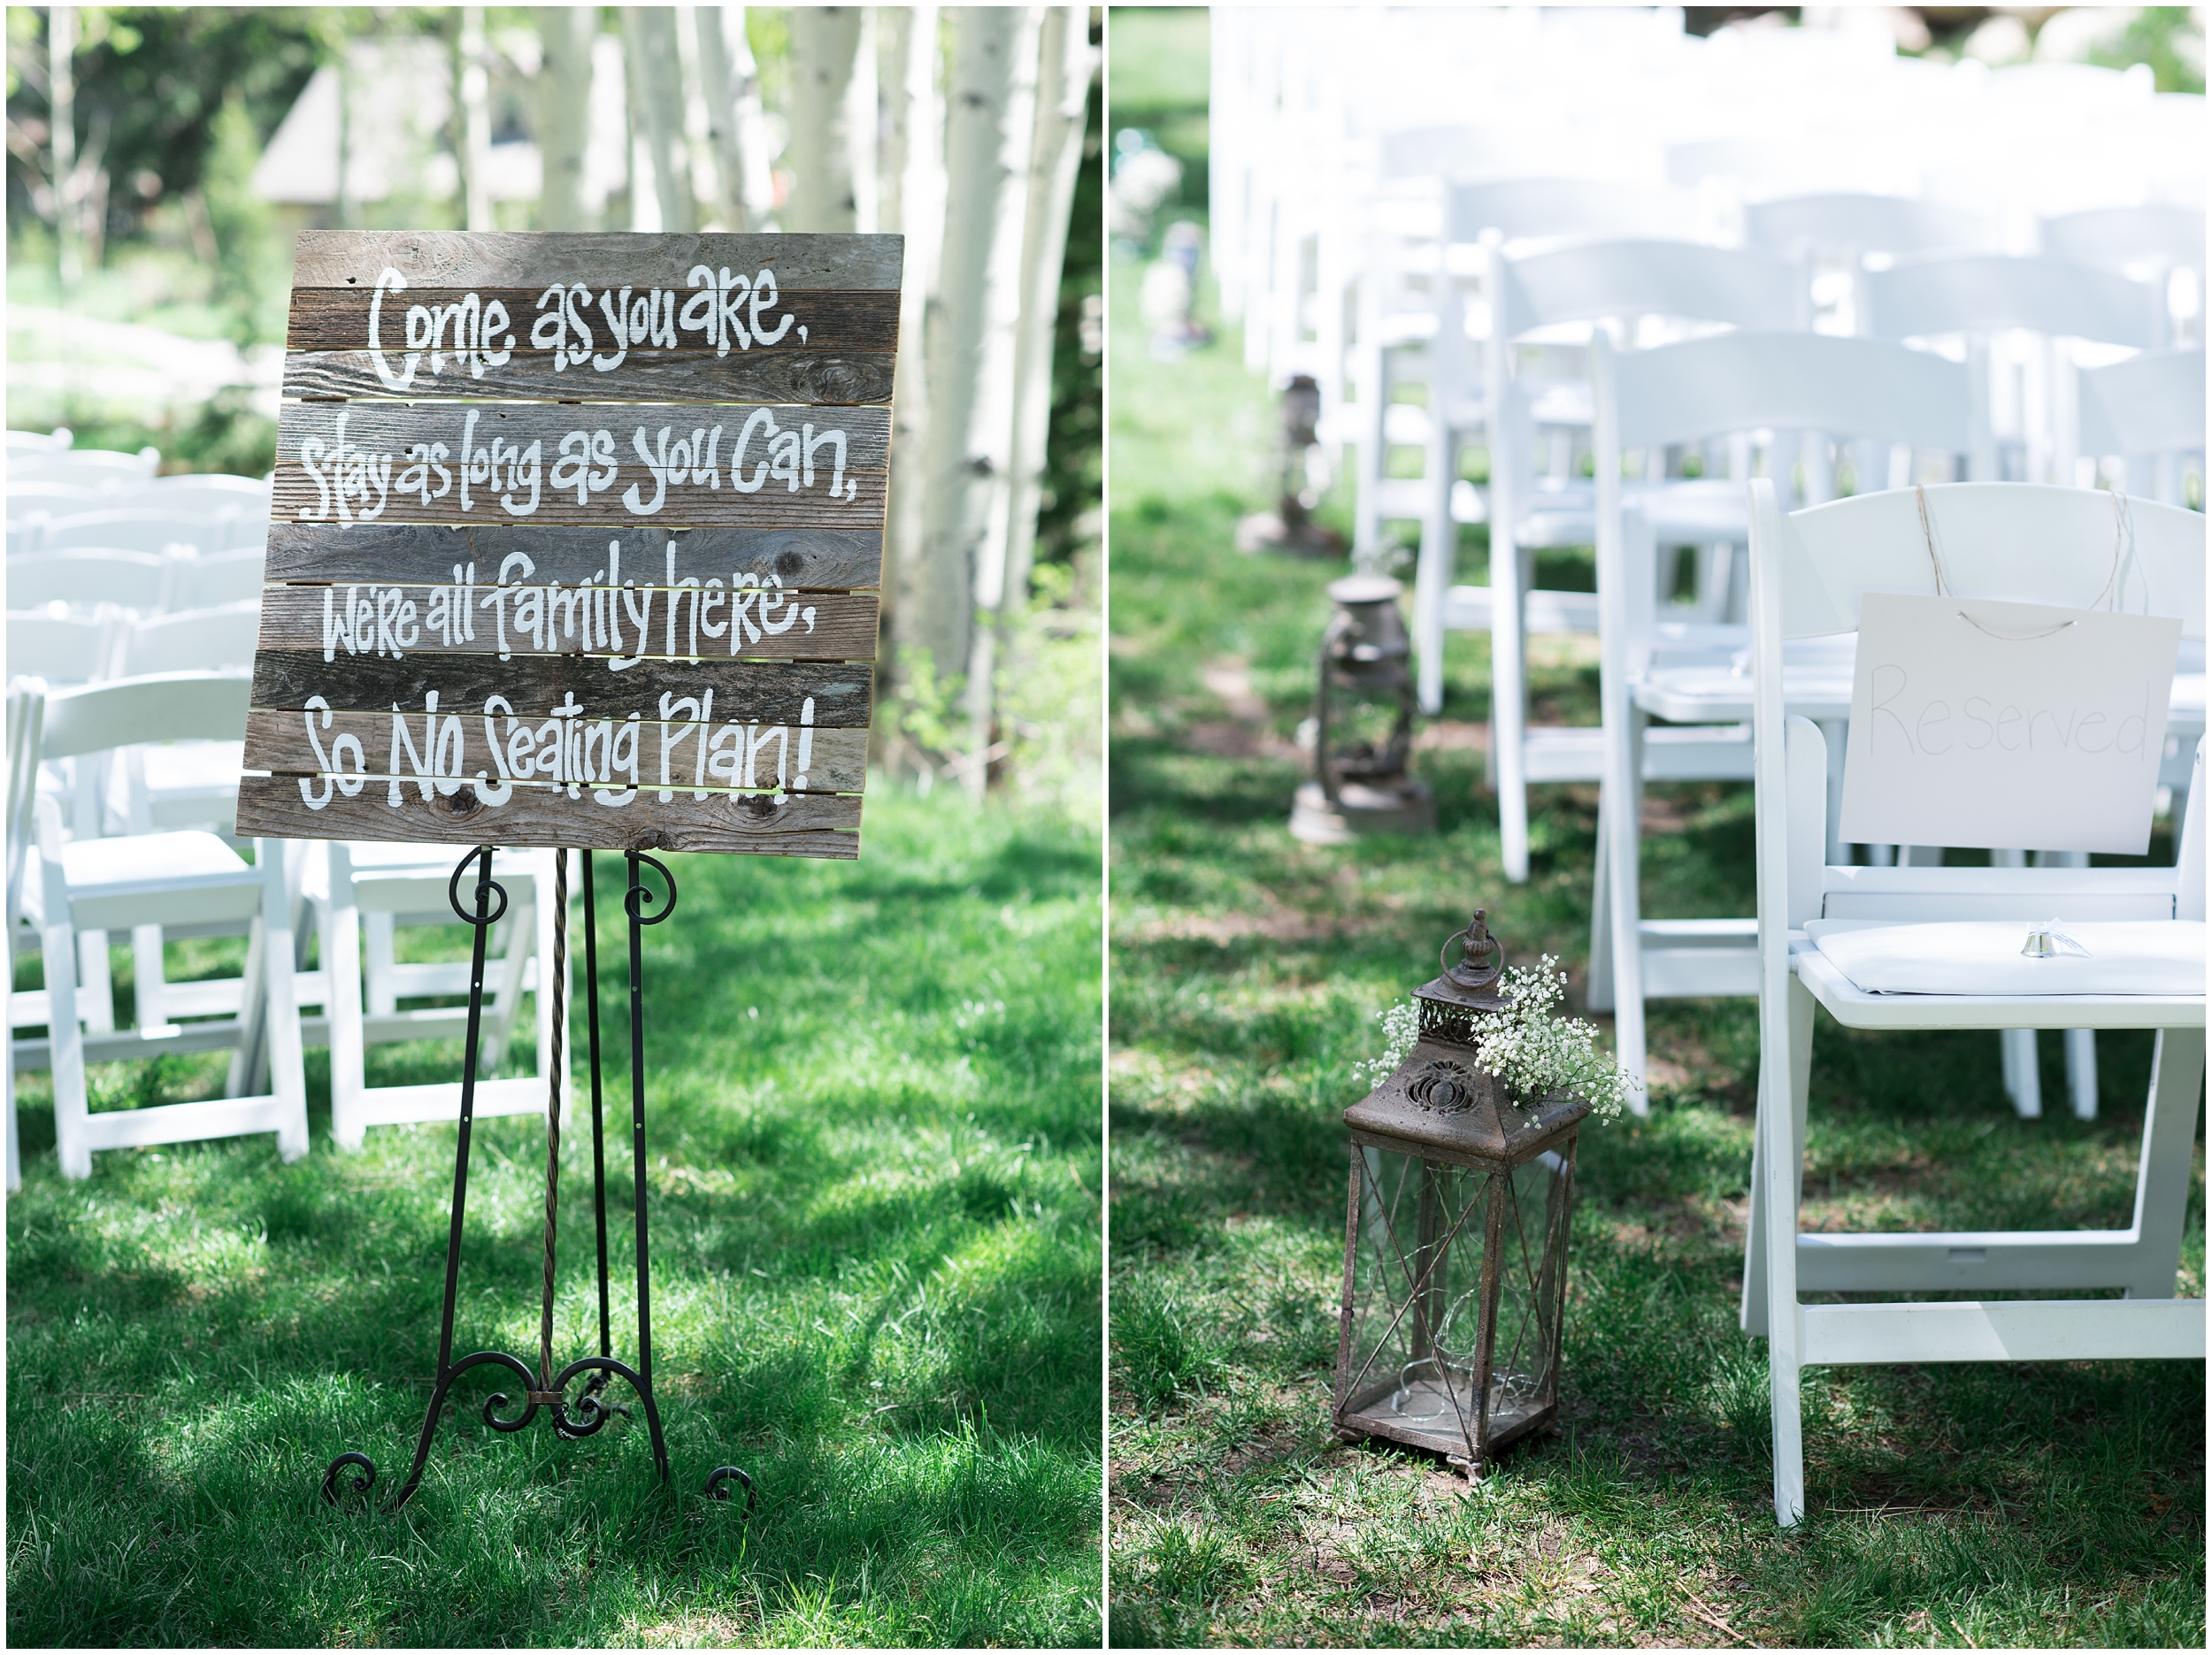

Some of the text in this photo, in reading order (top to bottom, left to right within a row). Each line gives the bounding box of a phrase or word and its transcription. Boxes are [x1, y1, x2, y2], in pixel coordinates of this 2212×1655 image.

[370, 268, 513, 389] Come
[533, 284, 591, 370] as
[595, 287, 678, 370] you
[396, 443, 451, 505] as
[461, 410, 541, 514] long
[550, 432, 617, 504] as
[624, 426, 721, 513] you
[731, 409, 857, 500] Can,
[427, 565, 474, 646] all
[482, 542, 651, 670] family
[300, 690, 814, 808] So No Seating Plan!
[1871, 665, 2149, 760] Reserved
